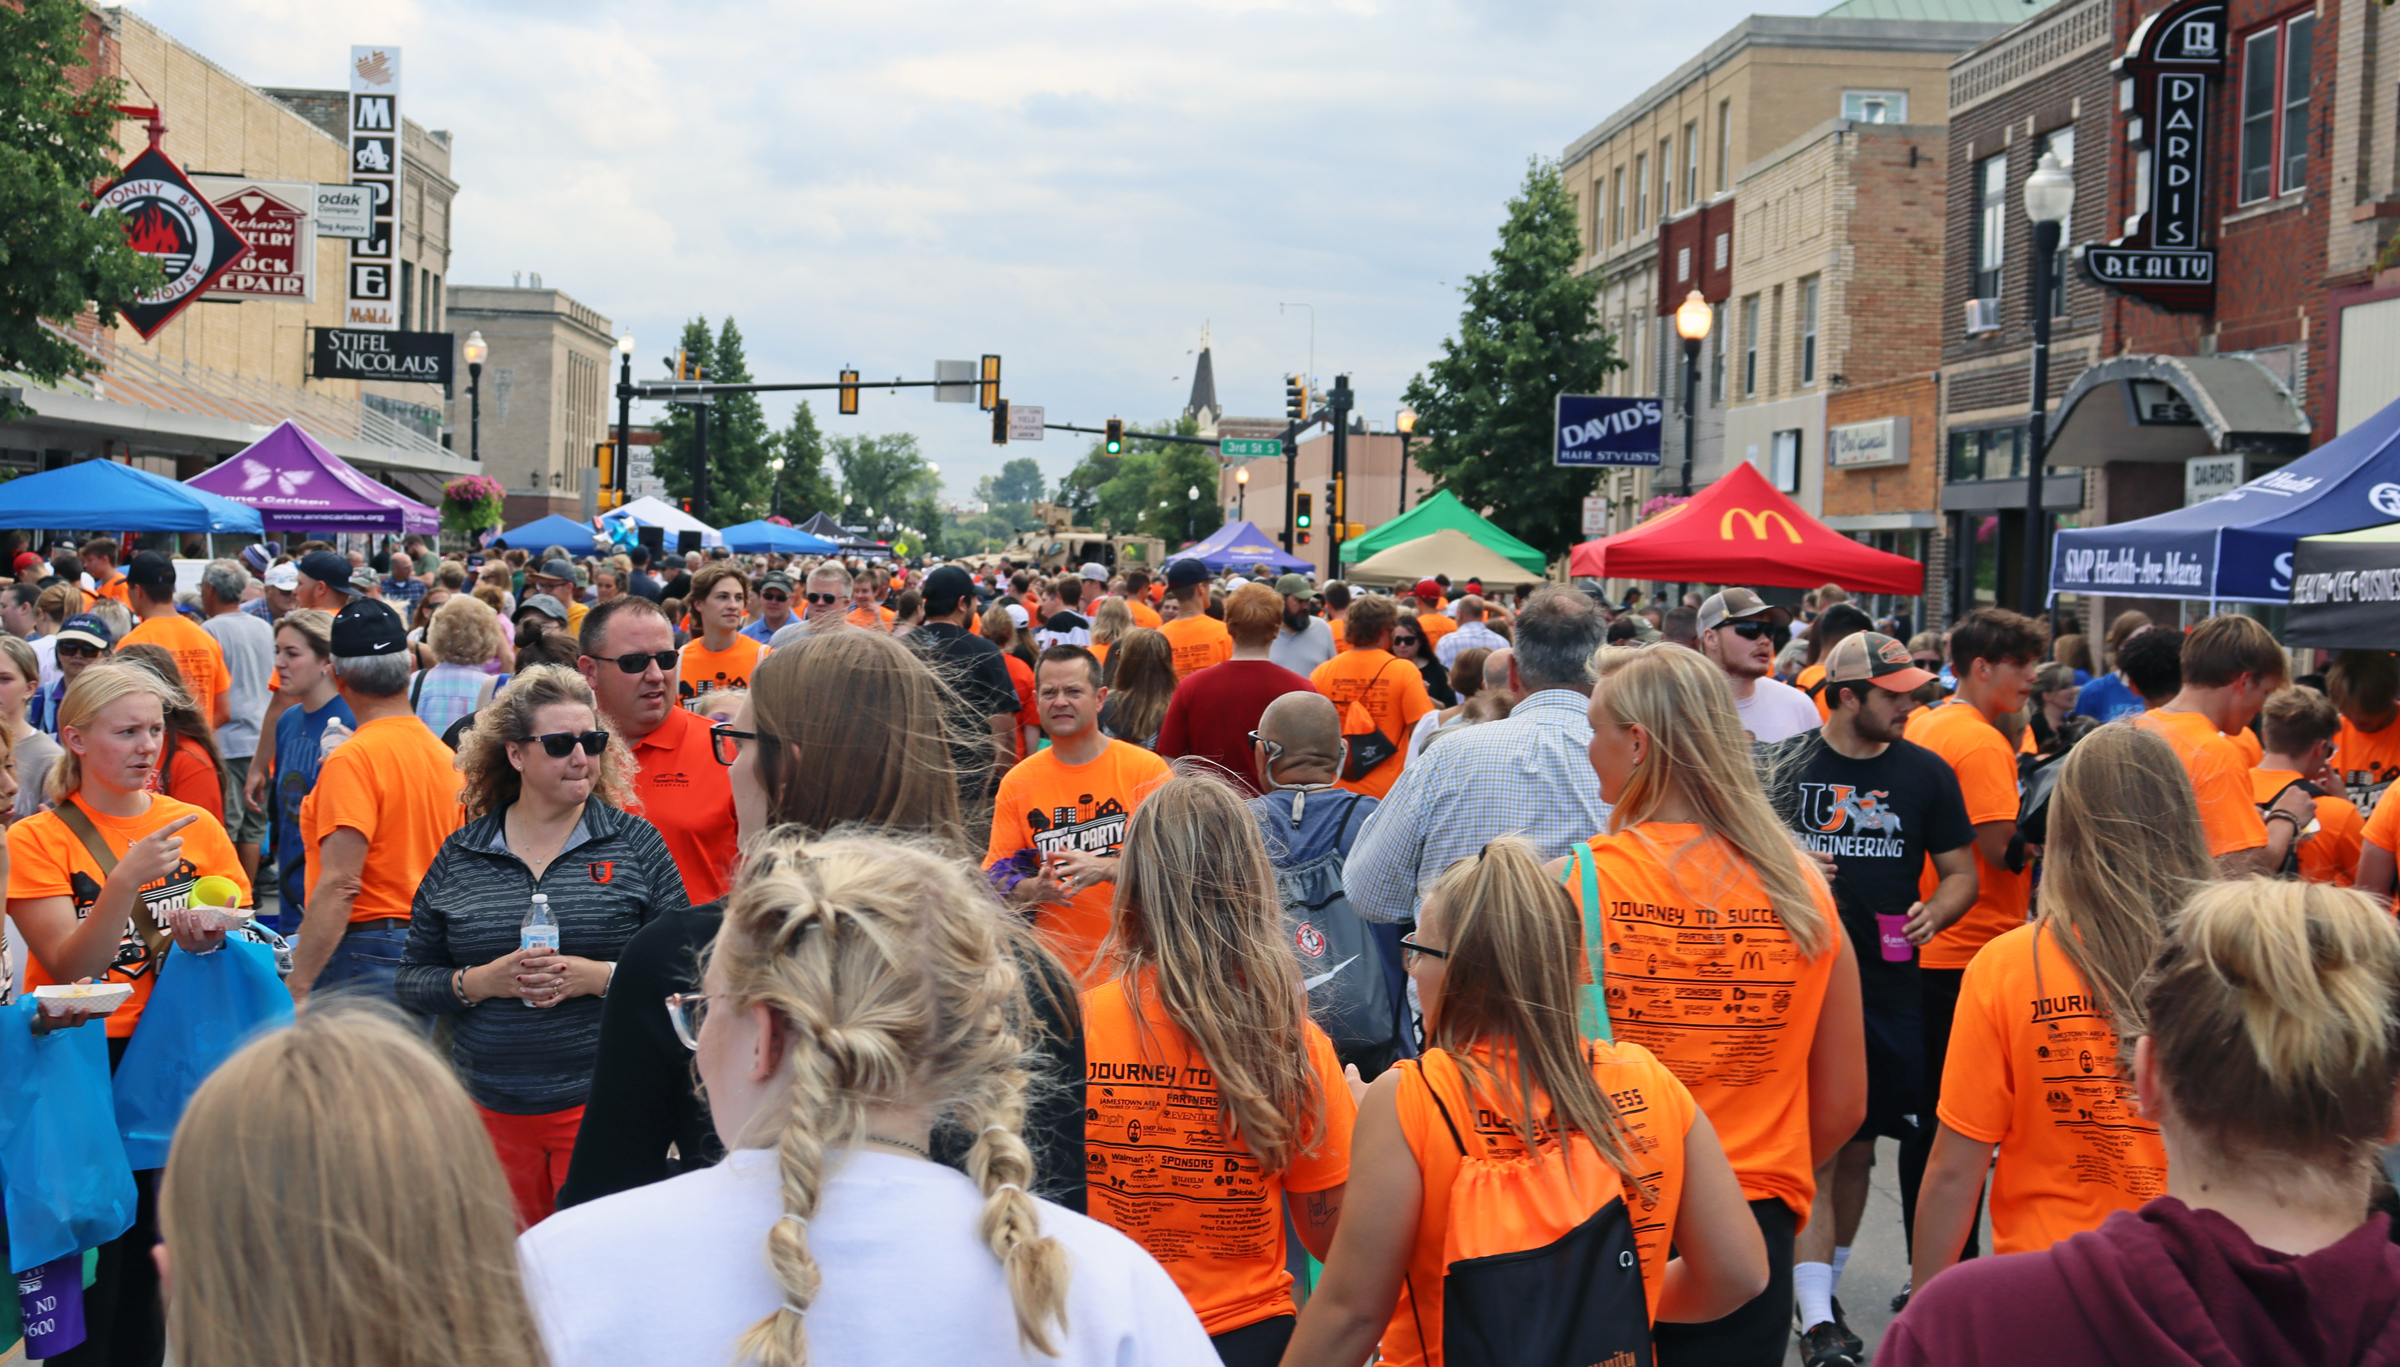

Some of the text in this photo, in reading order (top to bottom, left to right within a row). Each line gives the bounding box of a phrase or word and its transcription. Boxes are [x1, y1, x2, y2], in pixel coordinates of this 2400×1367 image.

[2166, 80, 2195, 243] DARDIS
[178, 194, 201, 217] B'S
[318, 192, 361, 206] odak
[337, 223, 365, 232] Agency
[232, 257, 289, 273] OCK
[2105, 256, 2207, 277] REALTY
[210, 274, 302, 292] EPAIR
[349, 306, 392, 324] MALL
[328, 330, 390, 352] STIFEL
[336, 350, 439, 374] NICOLAUS
[1561, 401, 1662, 448] DAVID'S
[1228, 442, 1275, 453] 3rd St S
[1561, 451, 1660, 462] HAIR STYLISTS
[2195, 463, 2235, 486] DARDIS
[263, 496, 330, 506] Carlsen
[273, 513, 385, 522] www.annecarlsen.org
[2064, 549, 2094, 583] SMP
[2164, 552, 2202, 586] Maria
[1080, 822, 1126, 850] PARTY
[1610, 901, 1779, 926] JOURNEY TO SUCCE
[2031, 994, 2096, 1020] JOURN
[1088, 1062, 1212, 1086] JOURNEY TO
[1100, 1098, 1143, 1106] JAMESTOWN
[1166, 1093, 1219, 1106] PARTNERS
[1172, 1111, 1218, 1122] EVENTIDE
[1158, 1125, 1177, 1133] Health
[1111, 1152, 1214, 1169] Walmart SPONSORS
[1171, 1174, 1205, 1184] WILHELM
[1239, 1177, 1253, 1185] ND
[36, 1295, 57, 1315] ND
